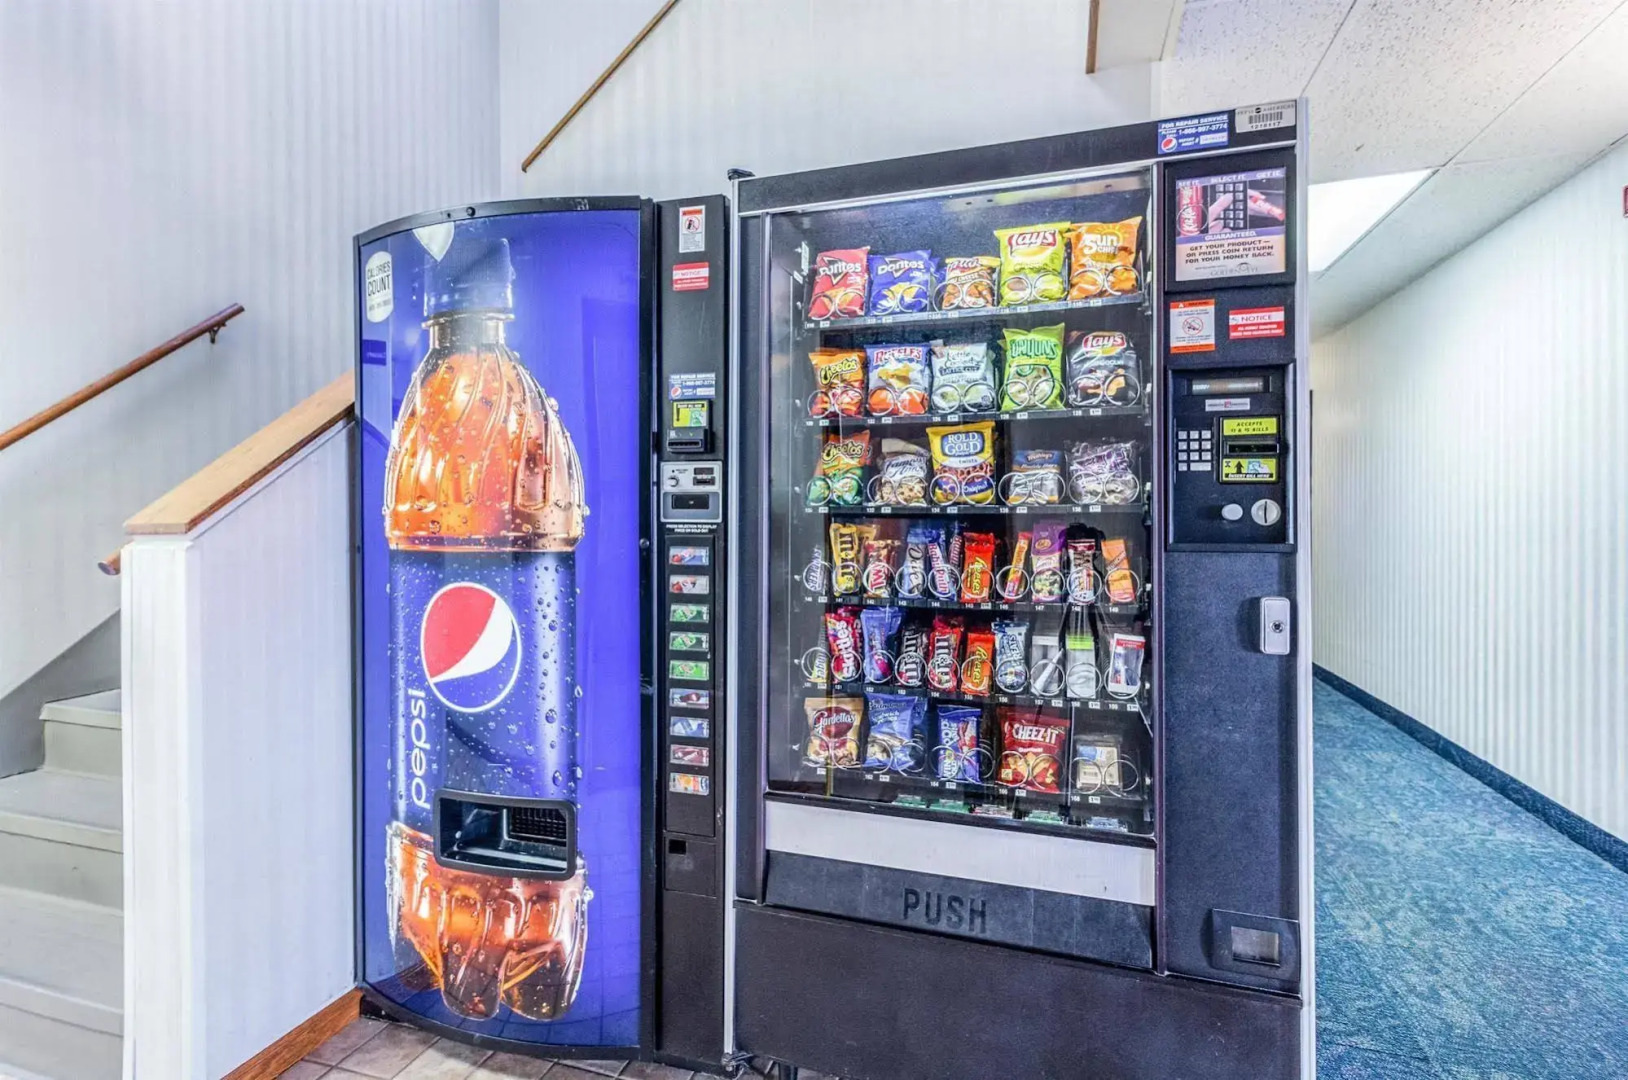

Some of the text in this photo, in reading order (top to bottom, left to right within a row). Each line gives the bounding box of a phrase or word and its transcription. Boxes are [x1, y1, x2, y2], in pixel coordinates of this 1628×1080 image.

[1083, 232, 1119, 254] Sun
[1190, 244, 1203, 252] GET
[1198, 249, 1220, 257] PRESS
[1221, 247, 1241, 255] COIN
[1242, 244, 1274, 252] RETURN
[1201, 255, 1221, 263] YOUR
[1223, 252, 1250, 261] MONEY
[819, 261, 862, 276] Doritos
[877, 258, 924, 275] Doritos
[367, 273, 391, 297] COUNT
[1240, 314, 1273, 323] NOTICE
[820, 358, 858, 385] Cheetos
[947, 432, 978, 443] ROLD
[821, 441, 864, 462] Cheetos
[944, 441, 980, 456] GOLD
[407, 689, 431, 810] pepsi
[902, 887, 987, 934] PUSH
